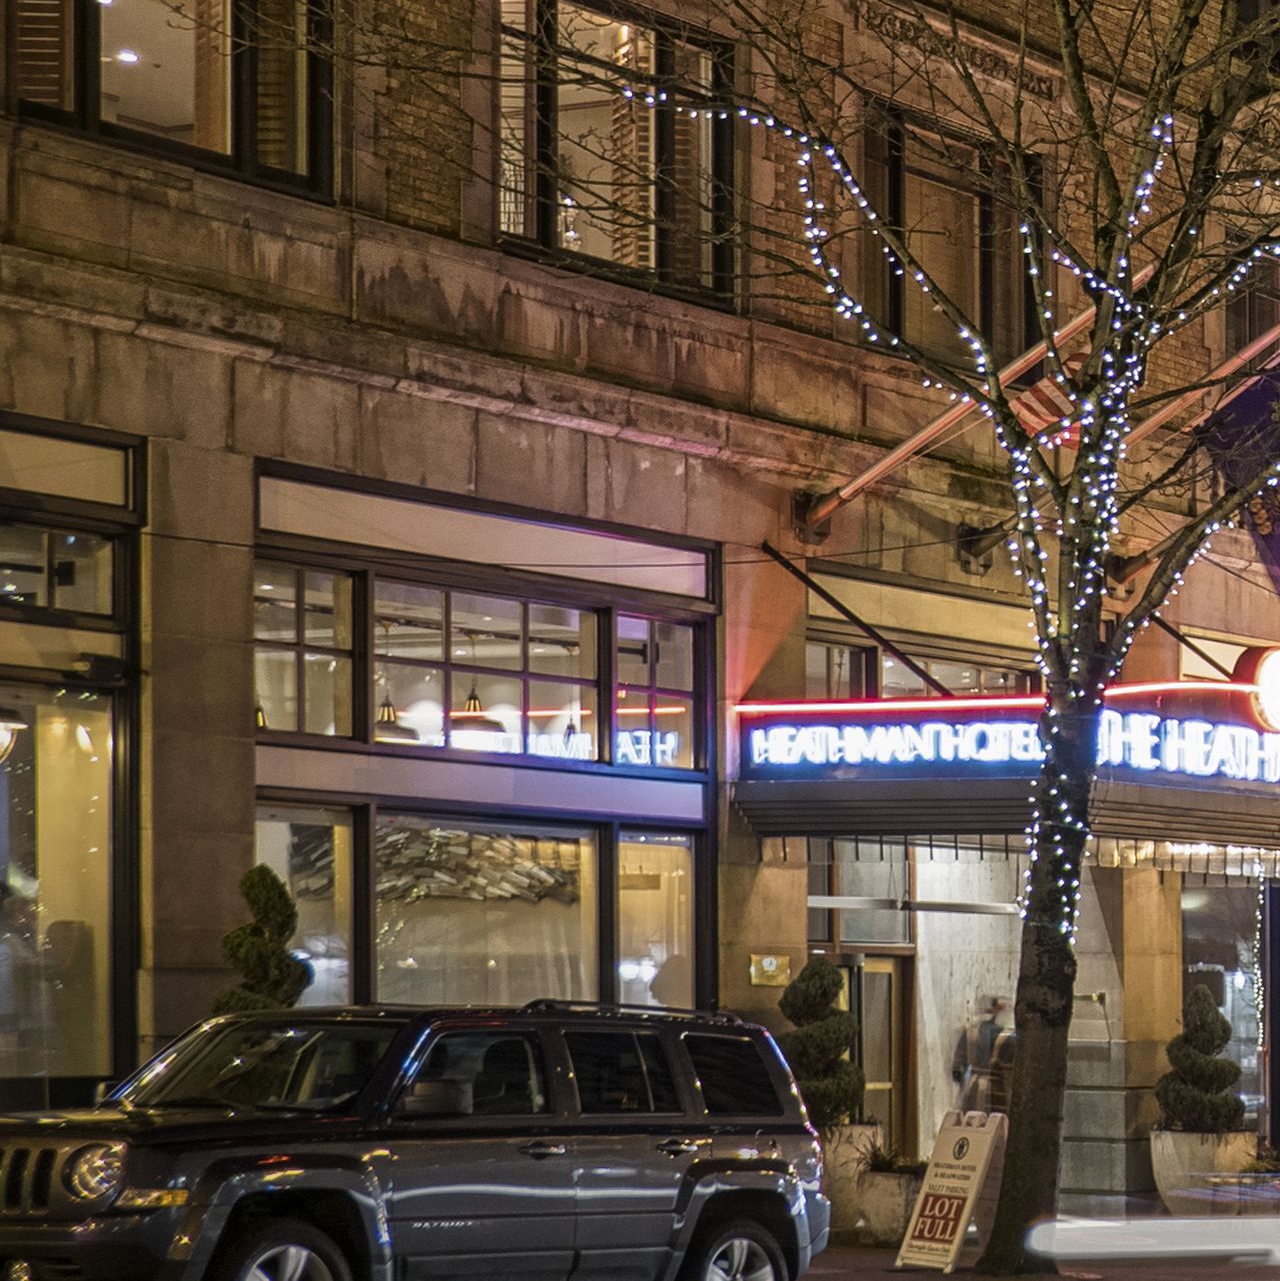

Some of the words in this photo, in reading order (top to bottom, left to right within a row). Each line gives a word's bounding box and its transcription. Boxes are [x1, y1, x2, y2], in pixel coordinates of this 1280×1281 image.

[752, 724, 937, 763] HEATHMAN
[1098, 709, 1162, 770] THE
[925, 1197, 962, 1217] LOT
[915, 1218, 954, 1240] FULL
